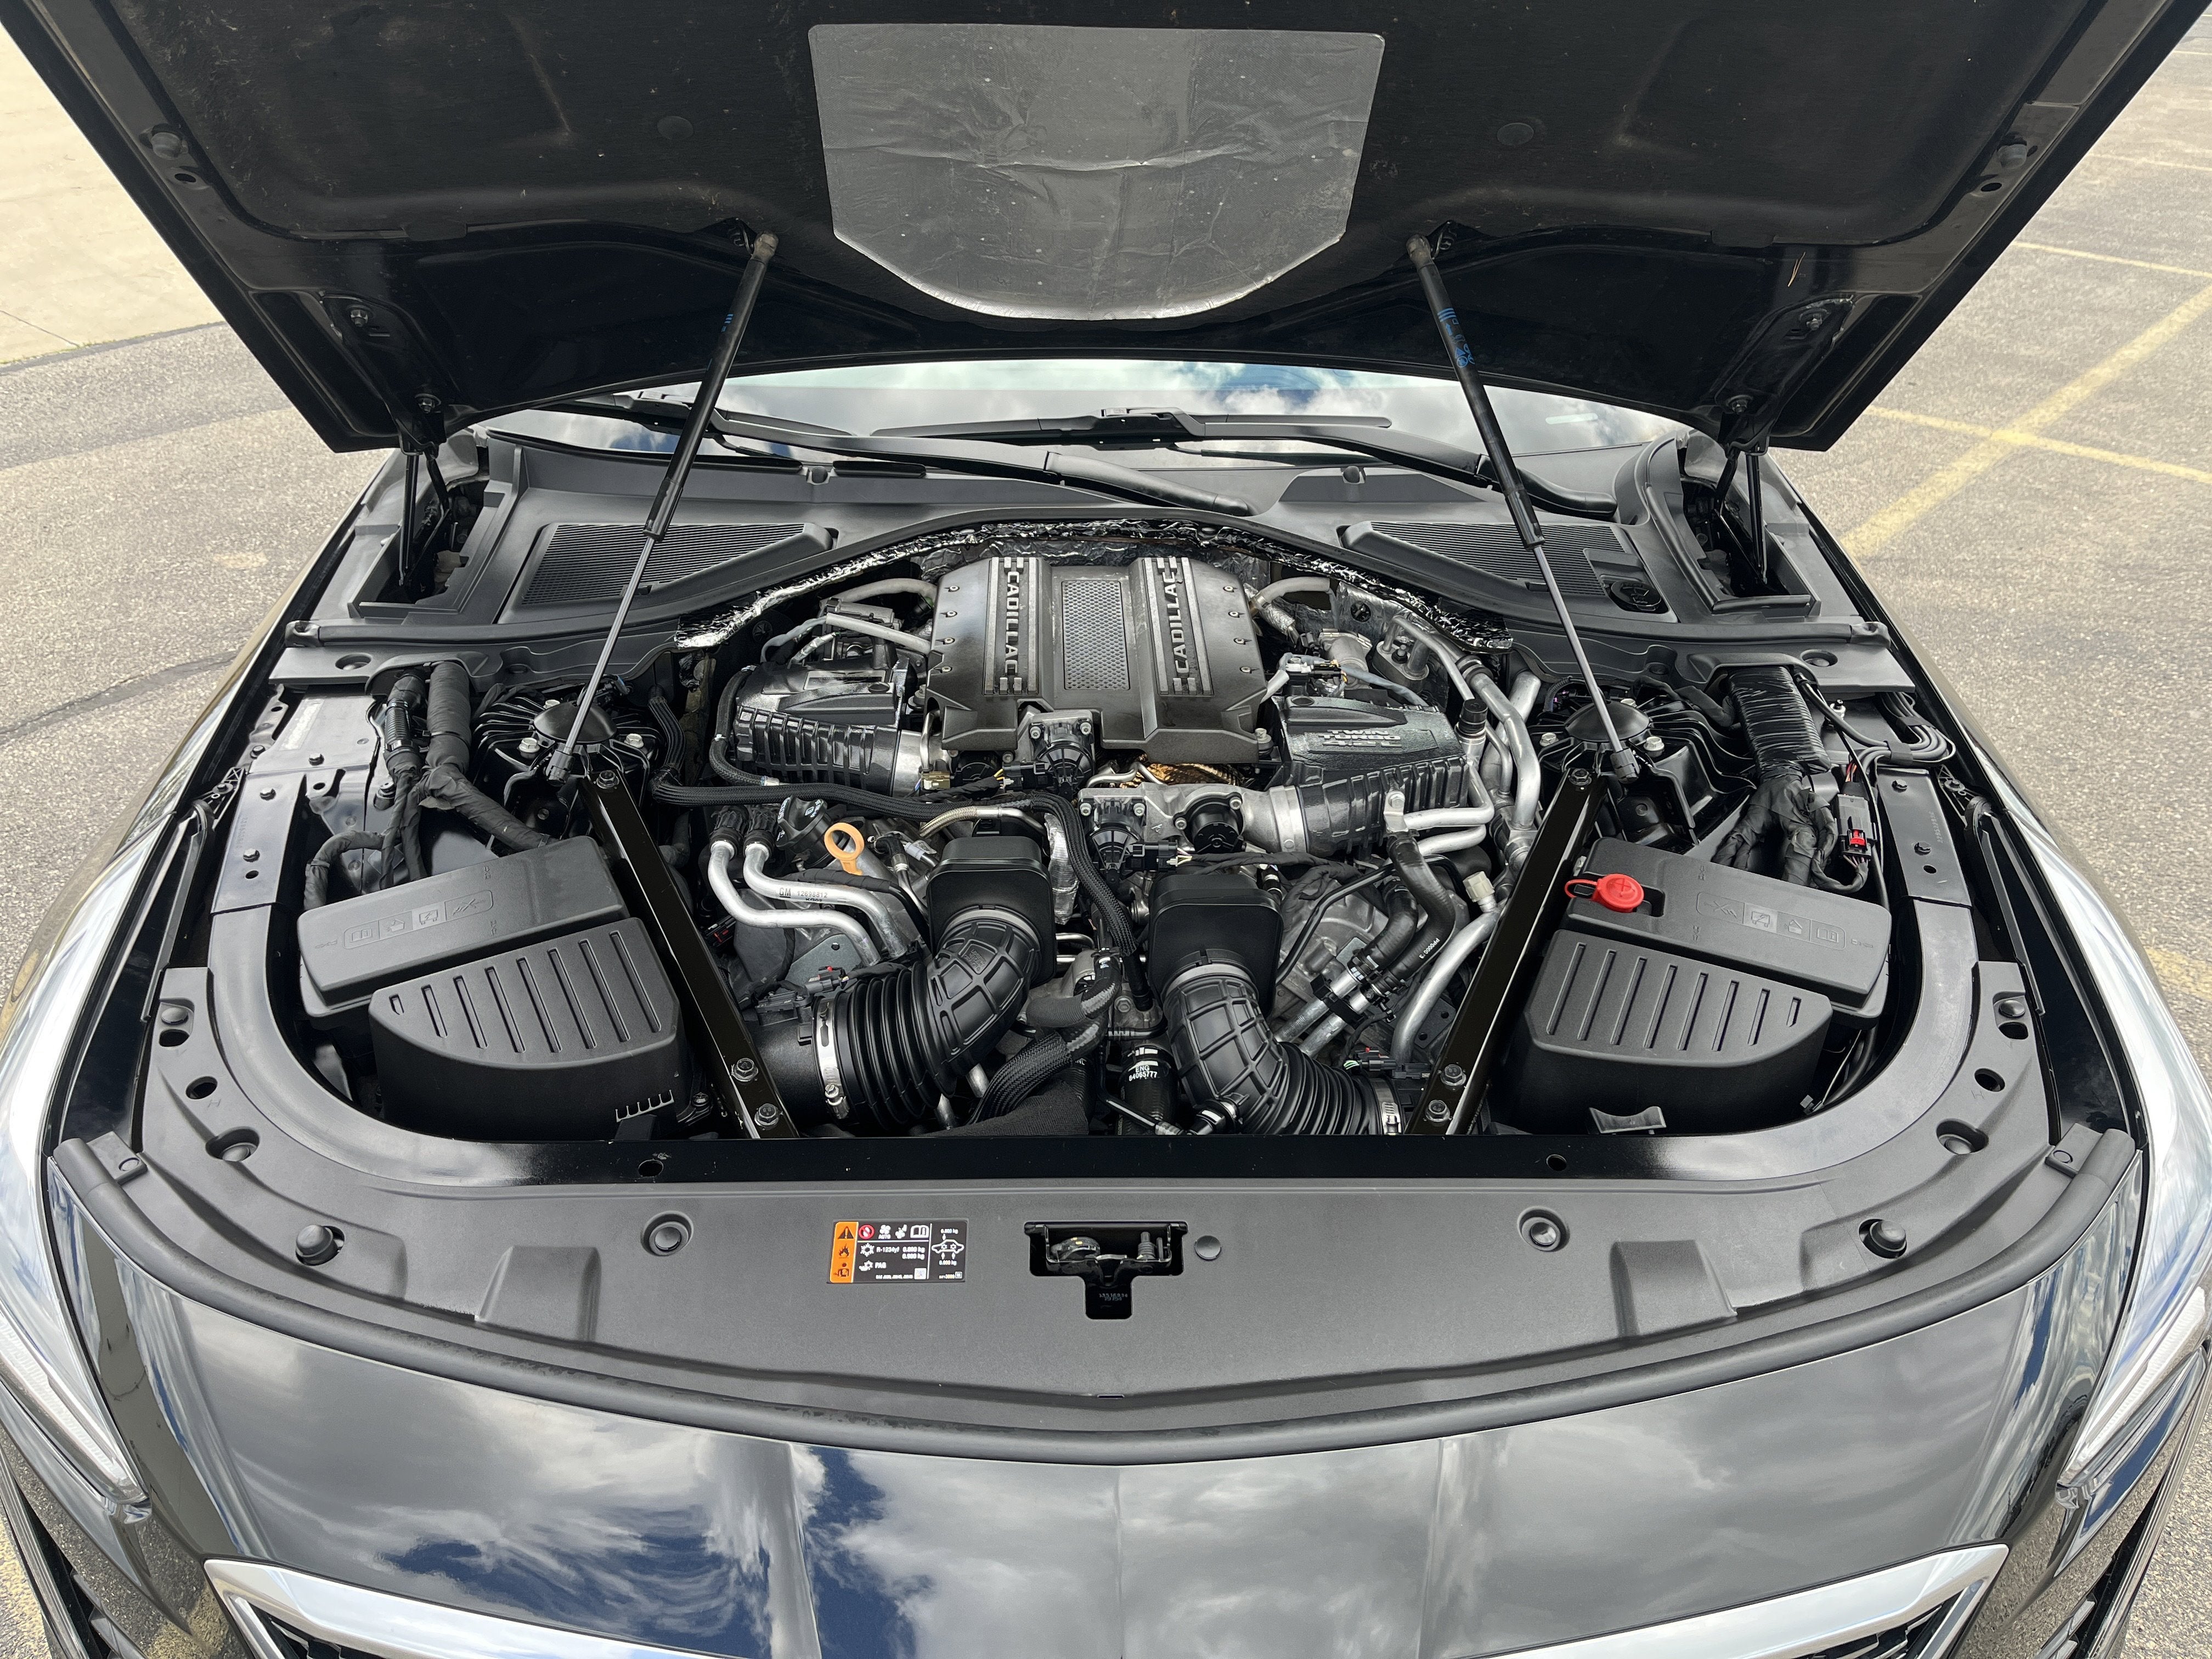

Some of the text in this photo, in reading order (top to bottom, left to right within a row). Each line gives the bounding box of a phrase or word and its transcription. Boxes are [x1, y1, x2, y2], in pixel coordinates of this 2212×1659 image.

[1005, 571, 1019, 674] CADILLAC
[1162, 571, 1189, 674] CADILLAC
[779, 887, 791, 896] GM
[1135, 1065, 1150, 1073] ENG
